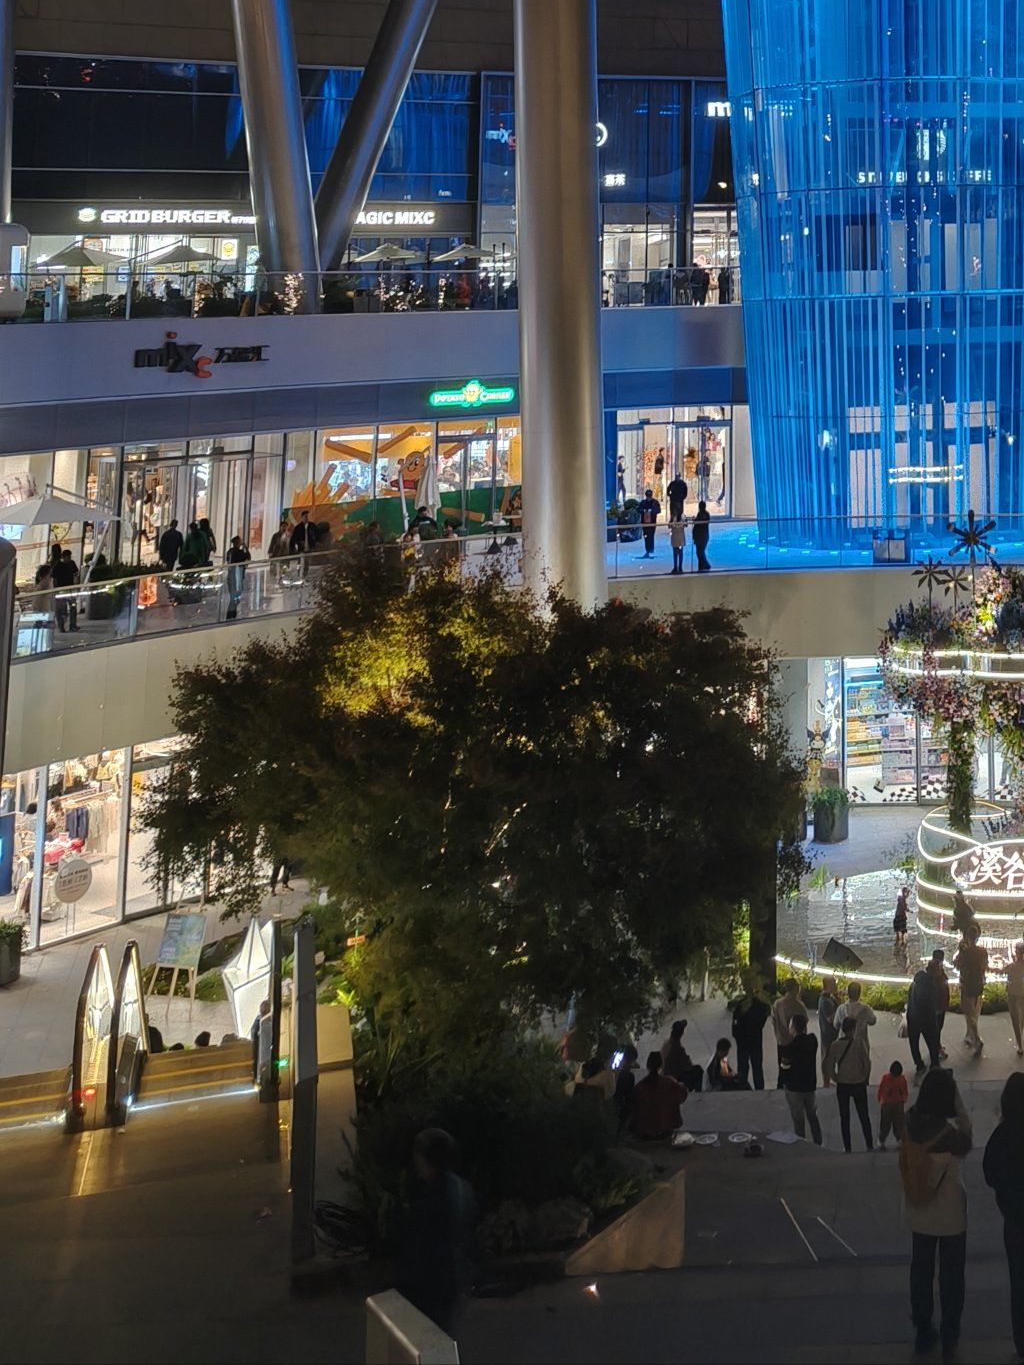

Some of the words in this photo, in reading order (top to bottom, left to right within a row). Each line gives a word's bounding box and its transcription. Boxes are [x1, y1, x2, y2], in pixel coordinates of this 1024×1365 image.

[101, 209, 150, 224] GRID
[150, 209, 231, 224] BURGER
[394, 211, 436, 225] MIXC
